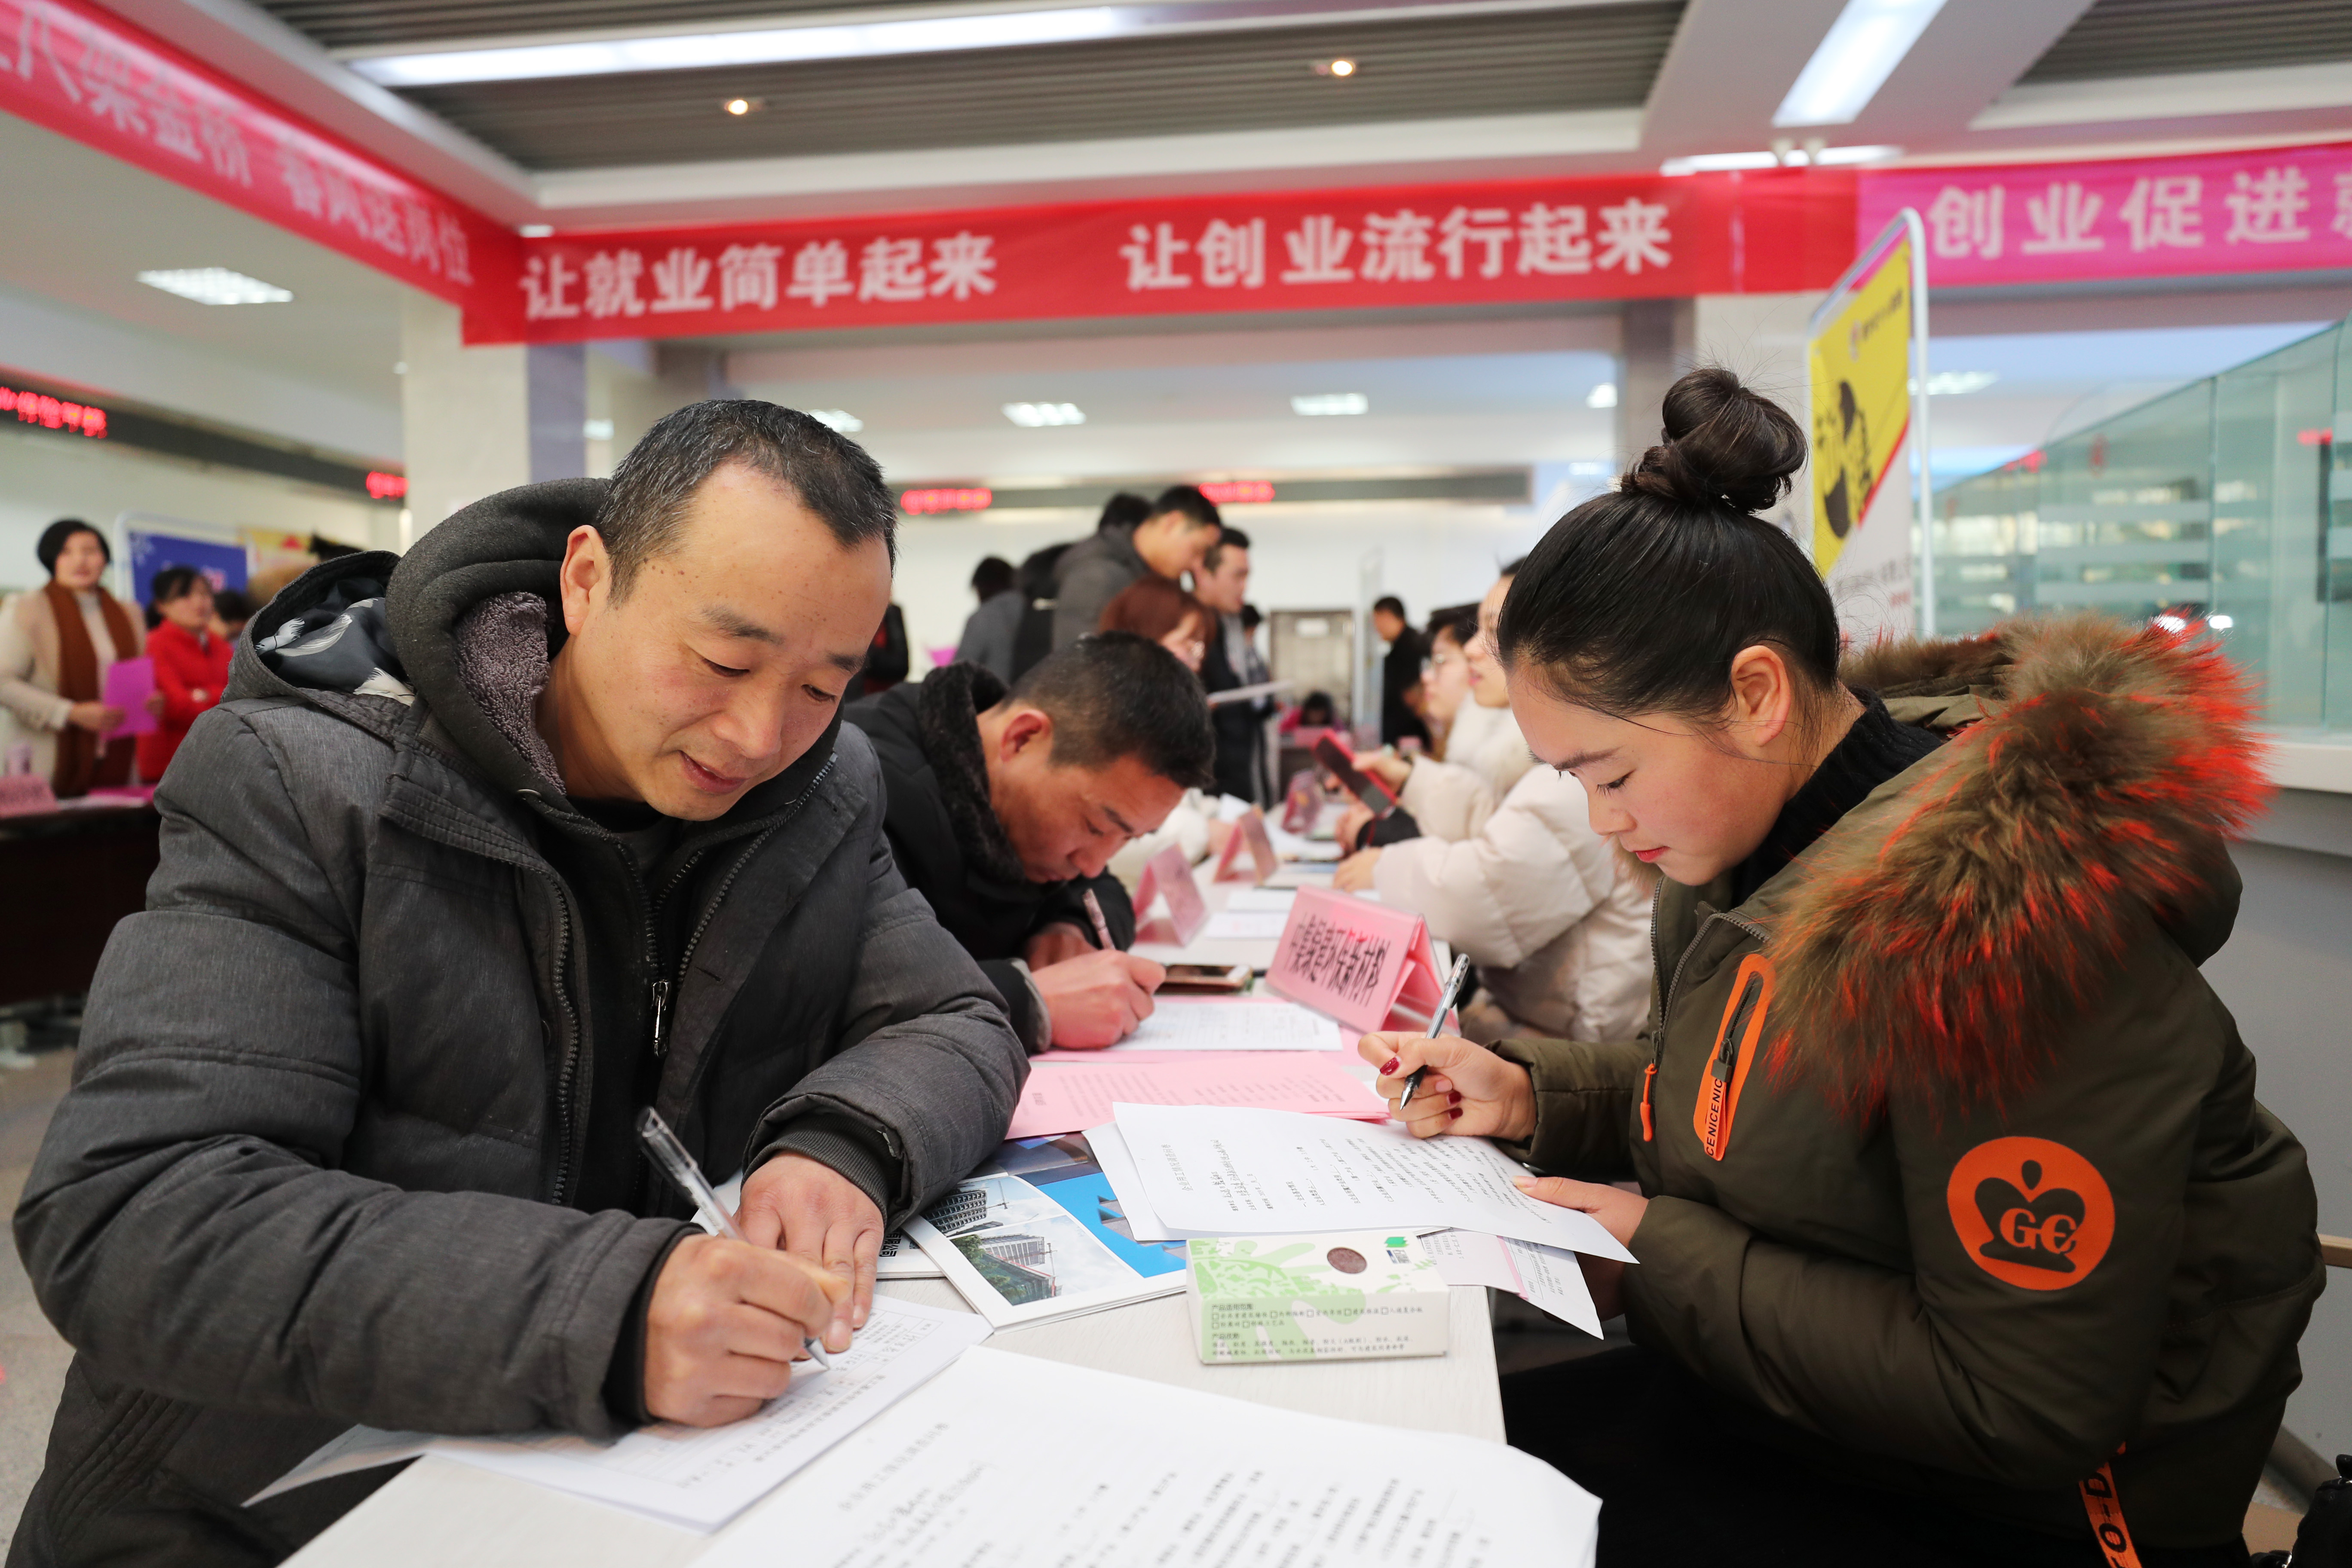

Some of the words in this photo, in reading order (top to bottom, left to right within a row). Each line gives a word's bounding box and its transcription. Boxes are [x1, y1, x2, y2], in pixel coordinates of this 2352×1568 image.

[1927, 167, 2352, 260] 创业促进
[519, 231, 997, 320] 让就业简单起来
[1120, 198, 1672, 289] 让创业流行起来
[1706, 1078, 1723, 1156] CENICENIC
[1161, 1144, 1193, 1191] 企业用工情况调查问卷
